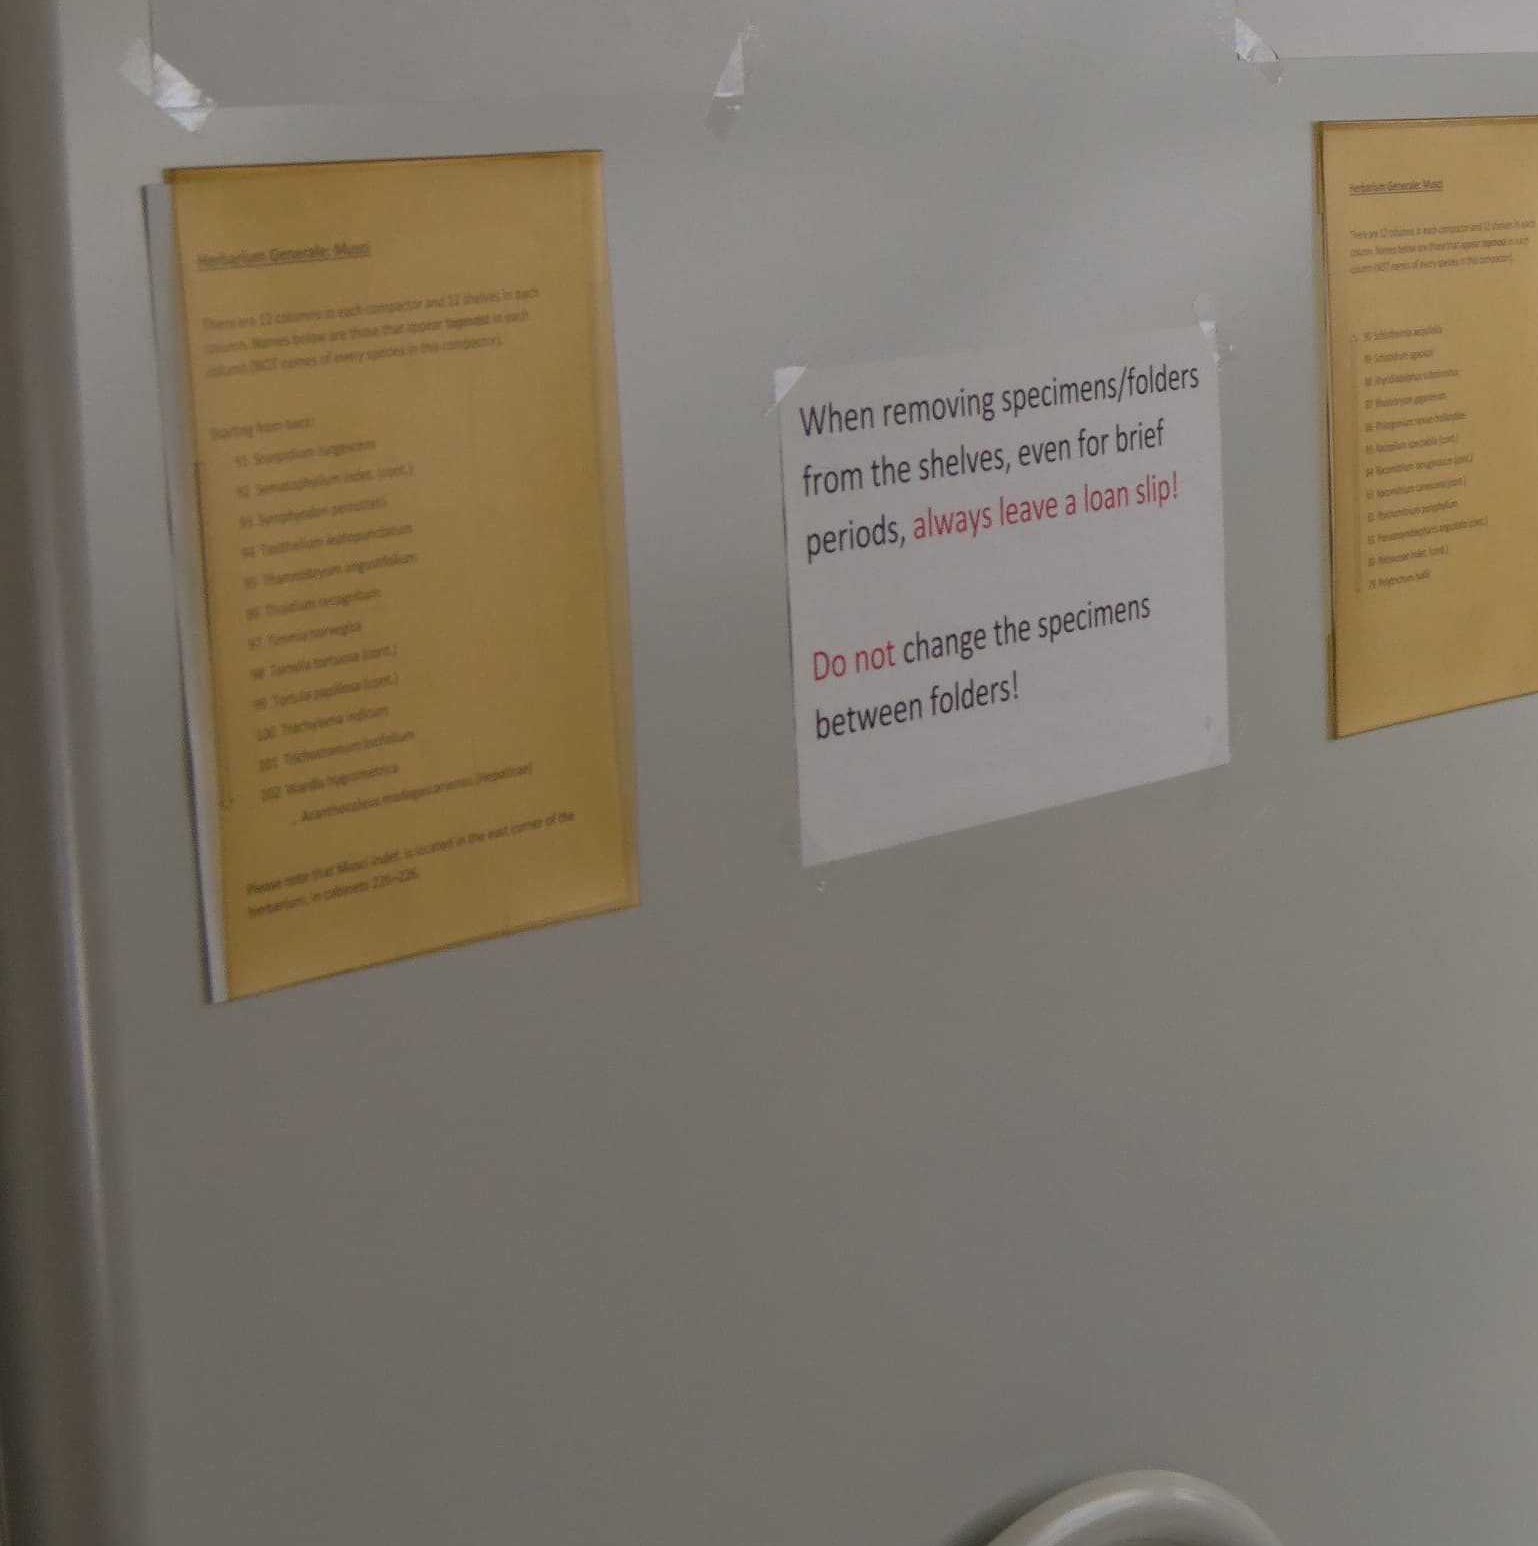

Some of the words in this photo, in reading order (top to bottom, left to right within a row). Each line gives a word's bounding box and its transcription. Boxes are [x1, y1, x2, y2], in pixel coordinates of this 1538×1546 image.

[799, 403, 875, 437] When
[882, 388, 995, 427] removing
[1002, 363, 1199, 415] specimens/folders
[802, 464, 863, 497] from
[871, 456, 911, 487] the
[919, 444, 1011, 481] shelves,
[1018, 436, 1071, 466] even
[1078, 428, 1109, 457] for
[1116, 418, 1165, 452] brief
[806, 513, 906, 564] periods,
[913, 504, 993, 539] always
[999, 495, 1058, 525] leave
[1065, 492, 1077, 516] a
[1084, 483, 1129, 512] loan
[1136, 471, 1179, 505] slip!
[813, 651, 847, 682] Do
[855, 640, 896, 674] not
[903, 626, 986, 664] change
[994, 615, 1031, 647] the
[1038, 596, 1151, 643] specimens
[815, 697, 922, 740] between
[930, 670, 1019, 715] folders!
